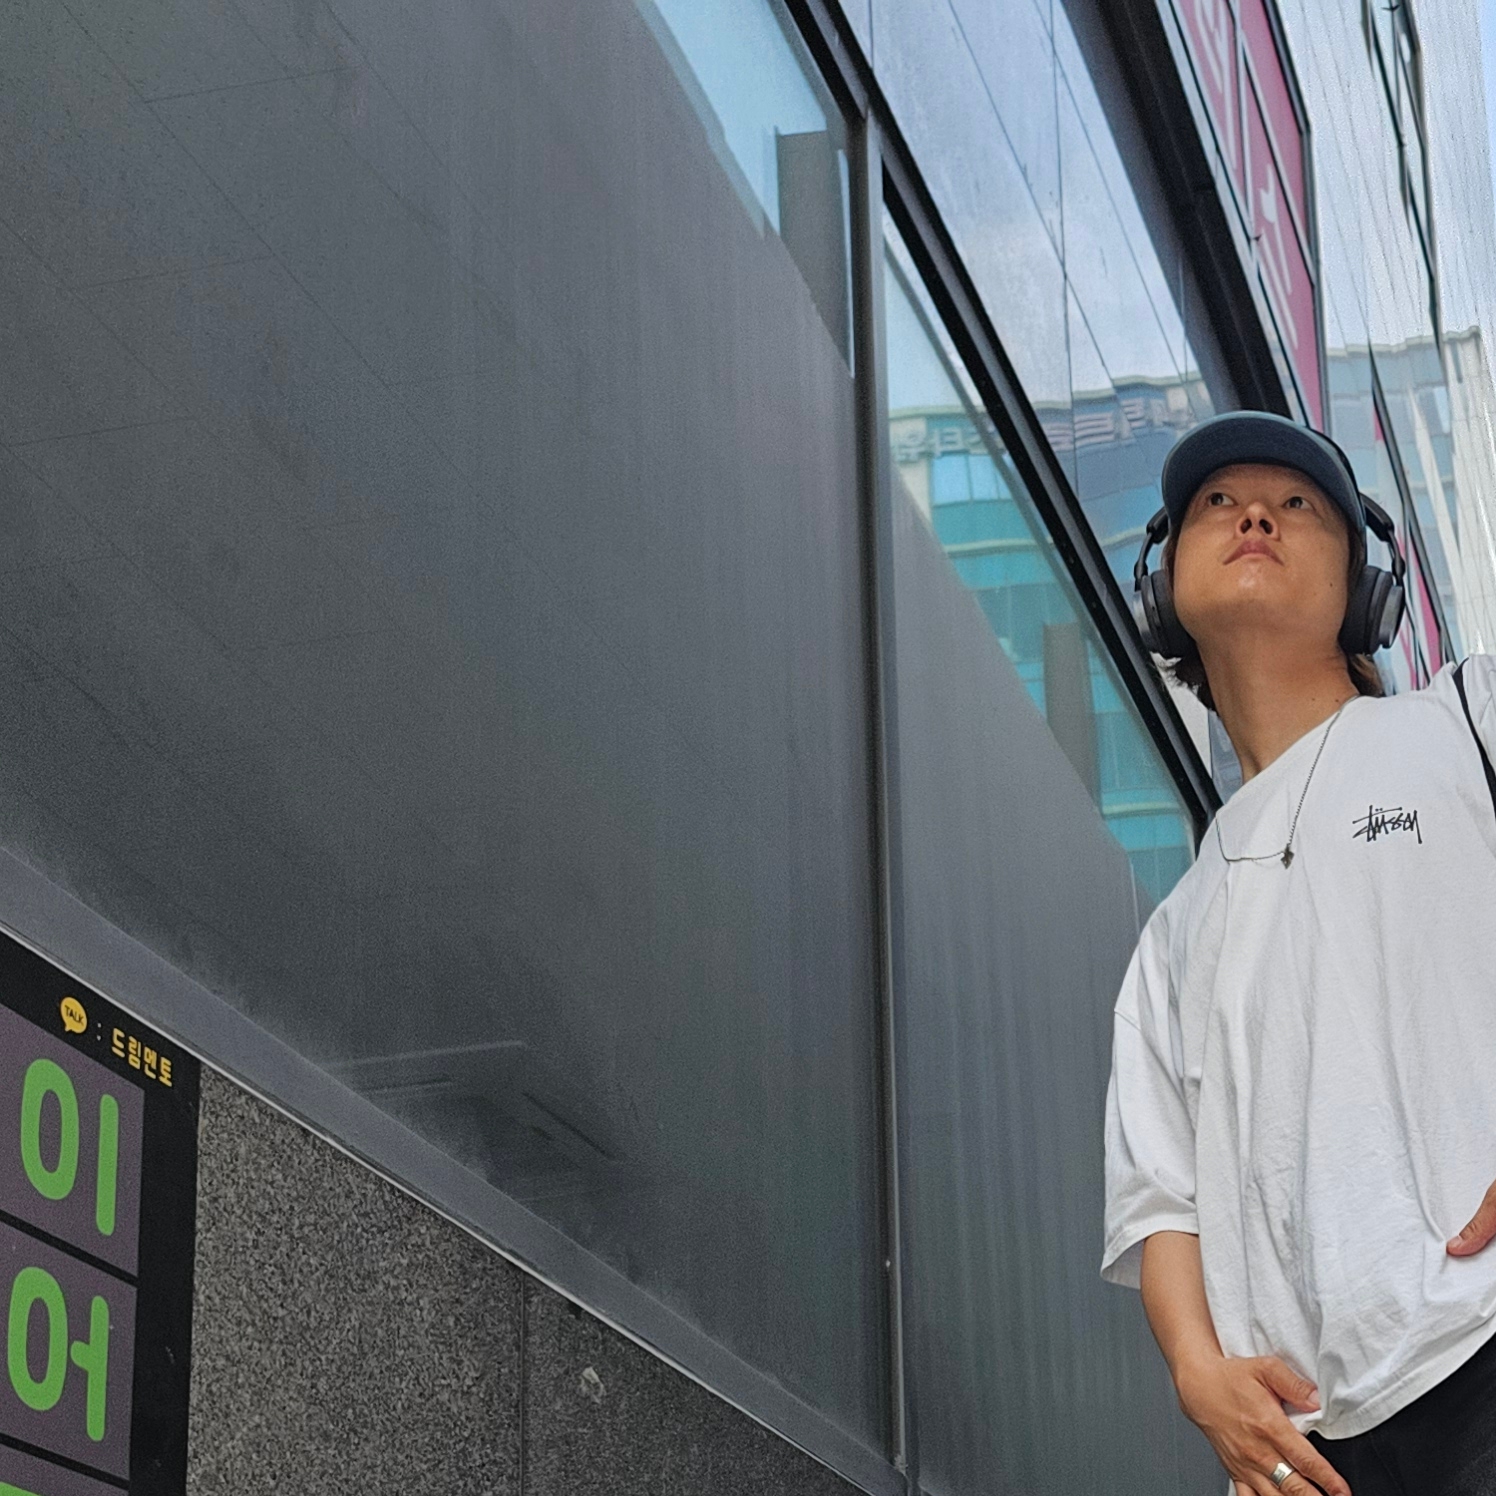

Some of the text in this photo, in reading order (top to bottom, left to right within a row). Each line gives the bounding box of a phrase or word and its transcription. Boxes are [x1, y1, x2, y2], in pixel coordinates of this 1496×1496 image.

[64, 1004, 85, 1026] TALK
[111, 1027, 173, 1087] 드림멘토
[20, 1058, 119, 1236] 이
[7, 1266, 110, 1441] 어
